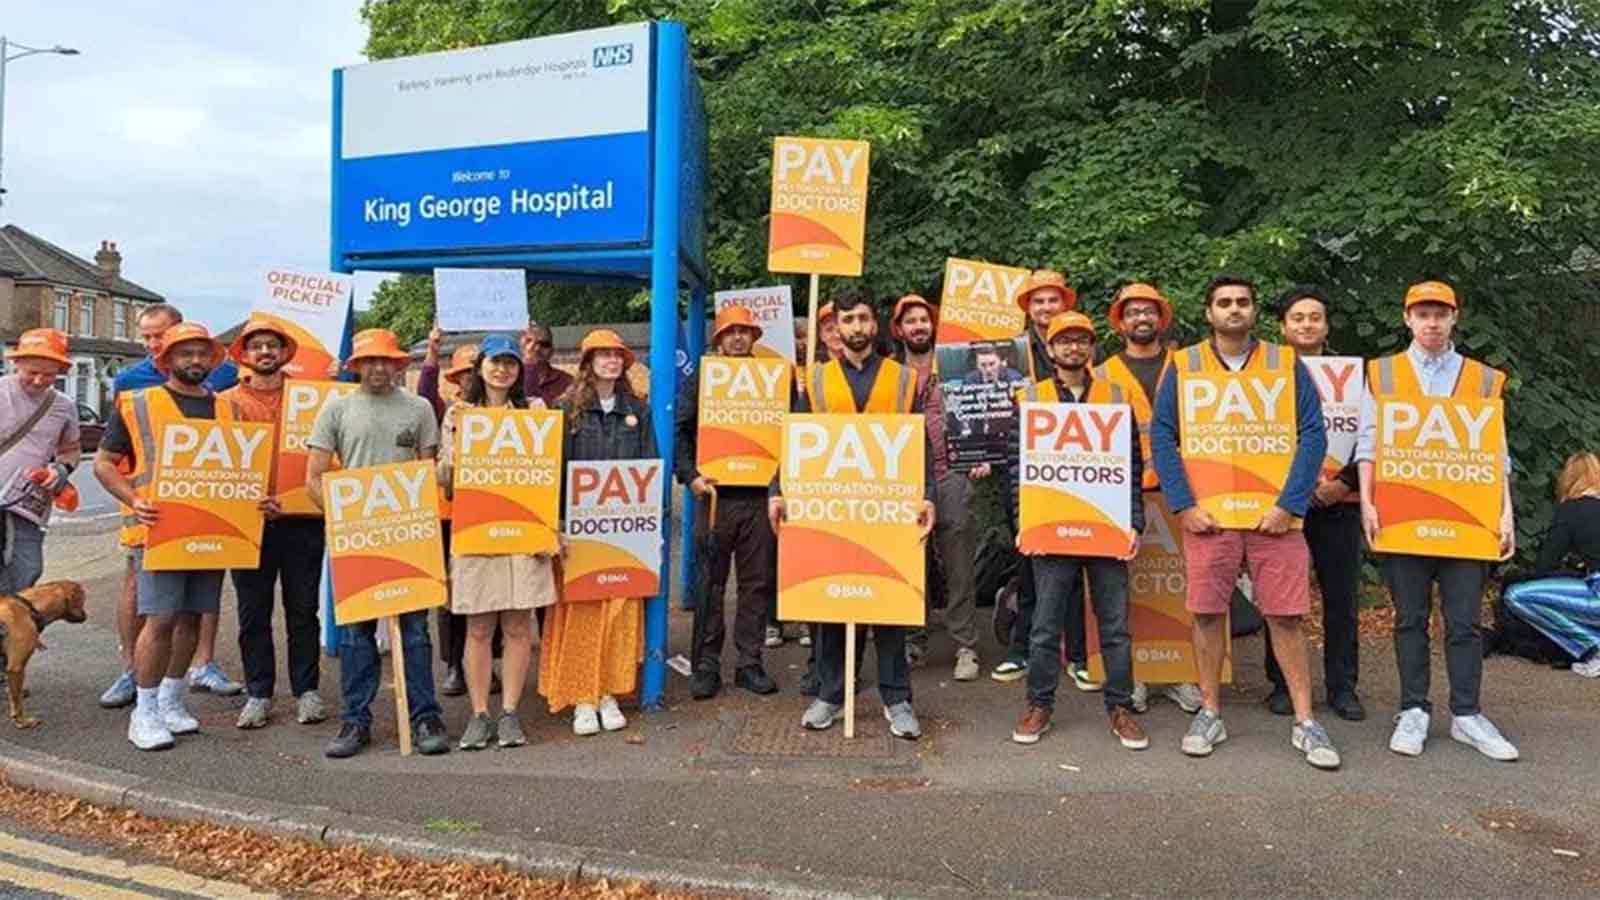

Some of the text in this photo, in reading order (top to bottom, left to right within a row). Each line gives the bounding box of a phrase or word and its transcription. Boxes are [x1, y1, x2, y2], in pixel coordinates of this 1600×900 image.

[595, 45, 632, 66] NHS
[476, 70, 493, 81] and
[544, 58, 587, 73] Hospitals
[451, 168, 510, 184] Welcome to
[777, 144, 863, 185] PAY
[364, 181, 614, 227] King George Hospital
[776, 193, 862, 212] DOCTORS
[266, 270, 345, 294] OFFICIAL
[947, 264, 1025, 305] PAY
[271, 286, 335, 307] PICKET
[752, 309, 779, 321] KET
[944, 306, 1021, 330] DOCTORS
[704, 361, 784, 399] PAY
[1183, 378, 1287, 422] PAY
[703, 408, 784, 425] DOCTORS
[1382, 401, 1495, 450] PAY
[461, 414, 556, 456] PAY
[1025, 409, 1124, 452] PAY
[1267, 423, 1290, 434] FOR
[161, 423, 268, 469] PAY
[787, 422, 916, 481] PAY
[1185, 434, 1291, 455] DOCTORS
[1471, 451, 1495, 462] FOR
[459, 467, 555, 486] DOCTORS
[1025, 464, 1125, 485] DOCTORS
[1382, 460, 1496, 484] DOCTORS
[157, 481, 262, 501] DOCTORS
[329, 467, 429, 521] PAY
[571, 466, 657, 506] PAY
[785, 481, 919, 497] RESTORATION FOR
[784, 498, 918, 525] DOCTORS
[569, 516, 657, 535] DOCTORS
[334, 522, 437, 553] DOCTORS
[841, 584, 873, 599] BMA
[1150, 649, 1183, 662] BMA
